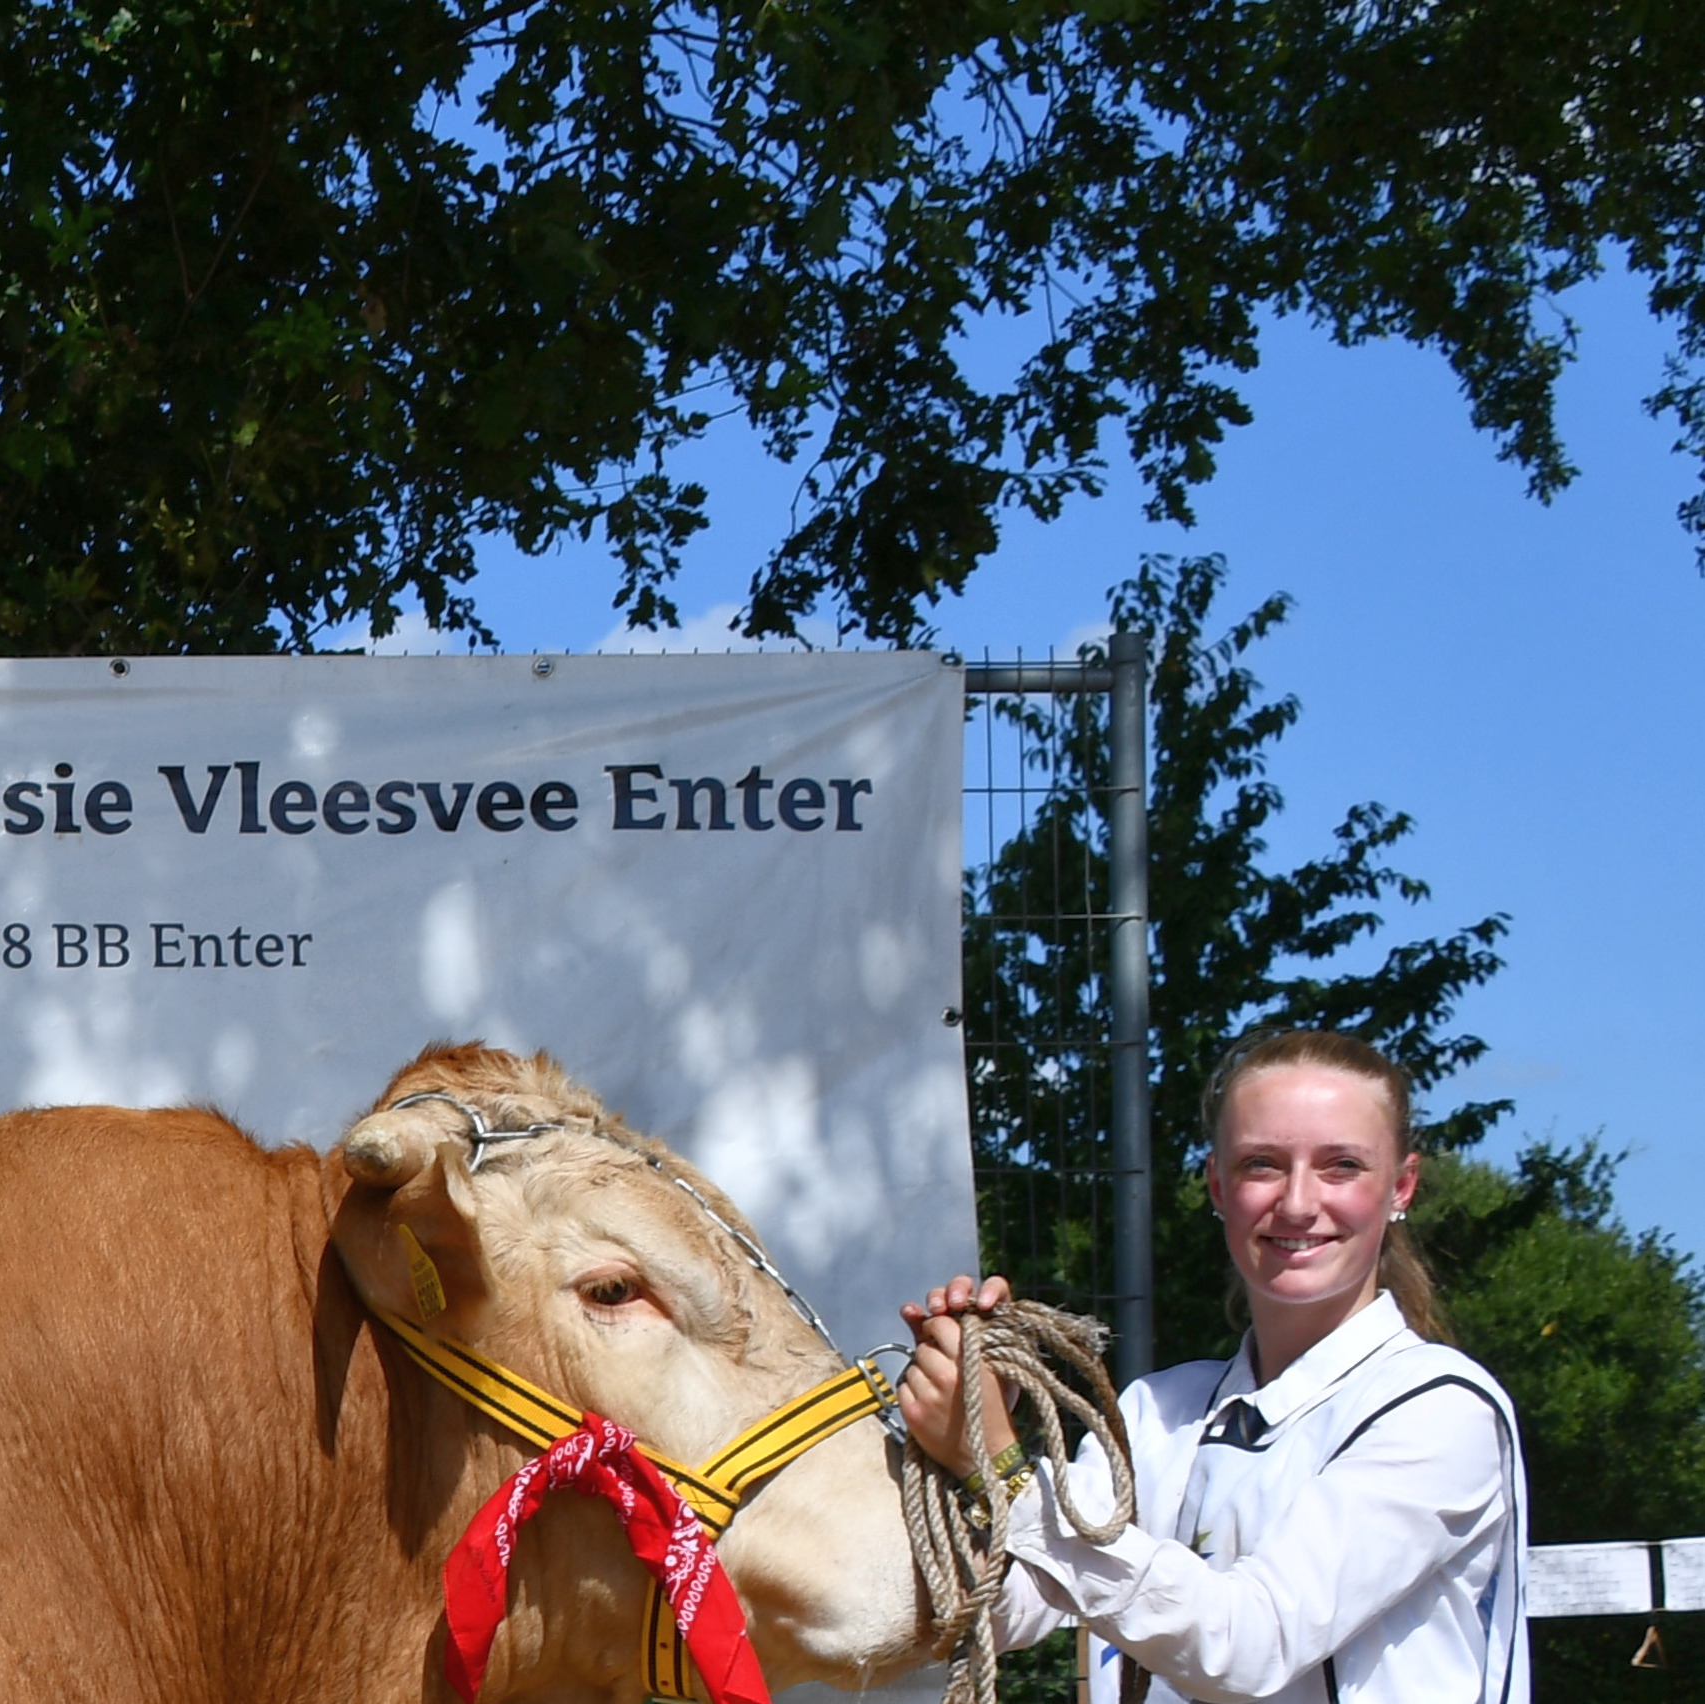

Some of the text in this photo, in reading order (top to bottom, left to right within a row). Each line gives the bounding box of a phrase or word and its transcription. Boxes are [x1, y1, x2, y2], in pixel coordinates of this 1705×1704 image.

[157, 760, 580, 835] Vleesvee
[604, 763, 873, 832] Enter
[51, 922, 131, 969] BB
[149, 922, 314, 969] Enter
